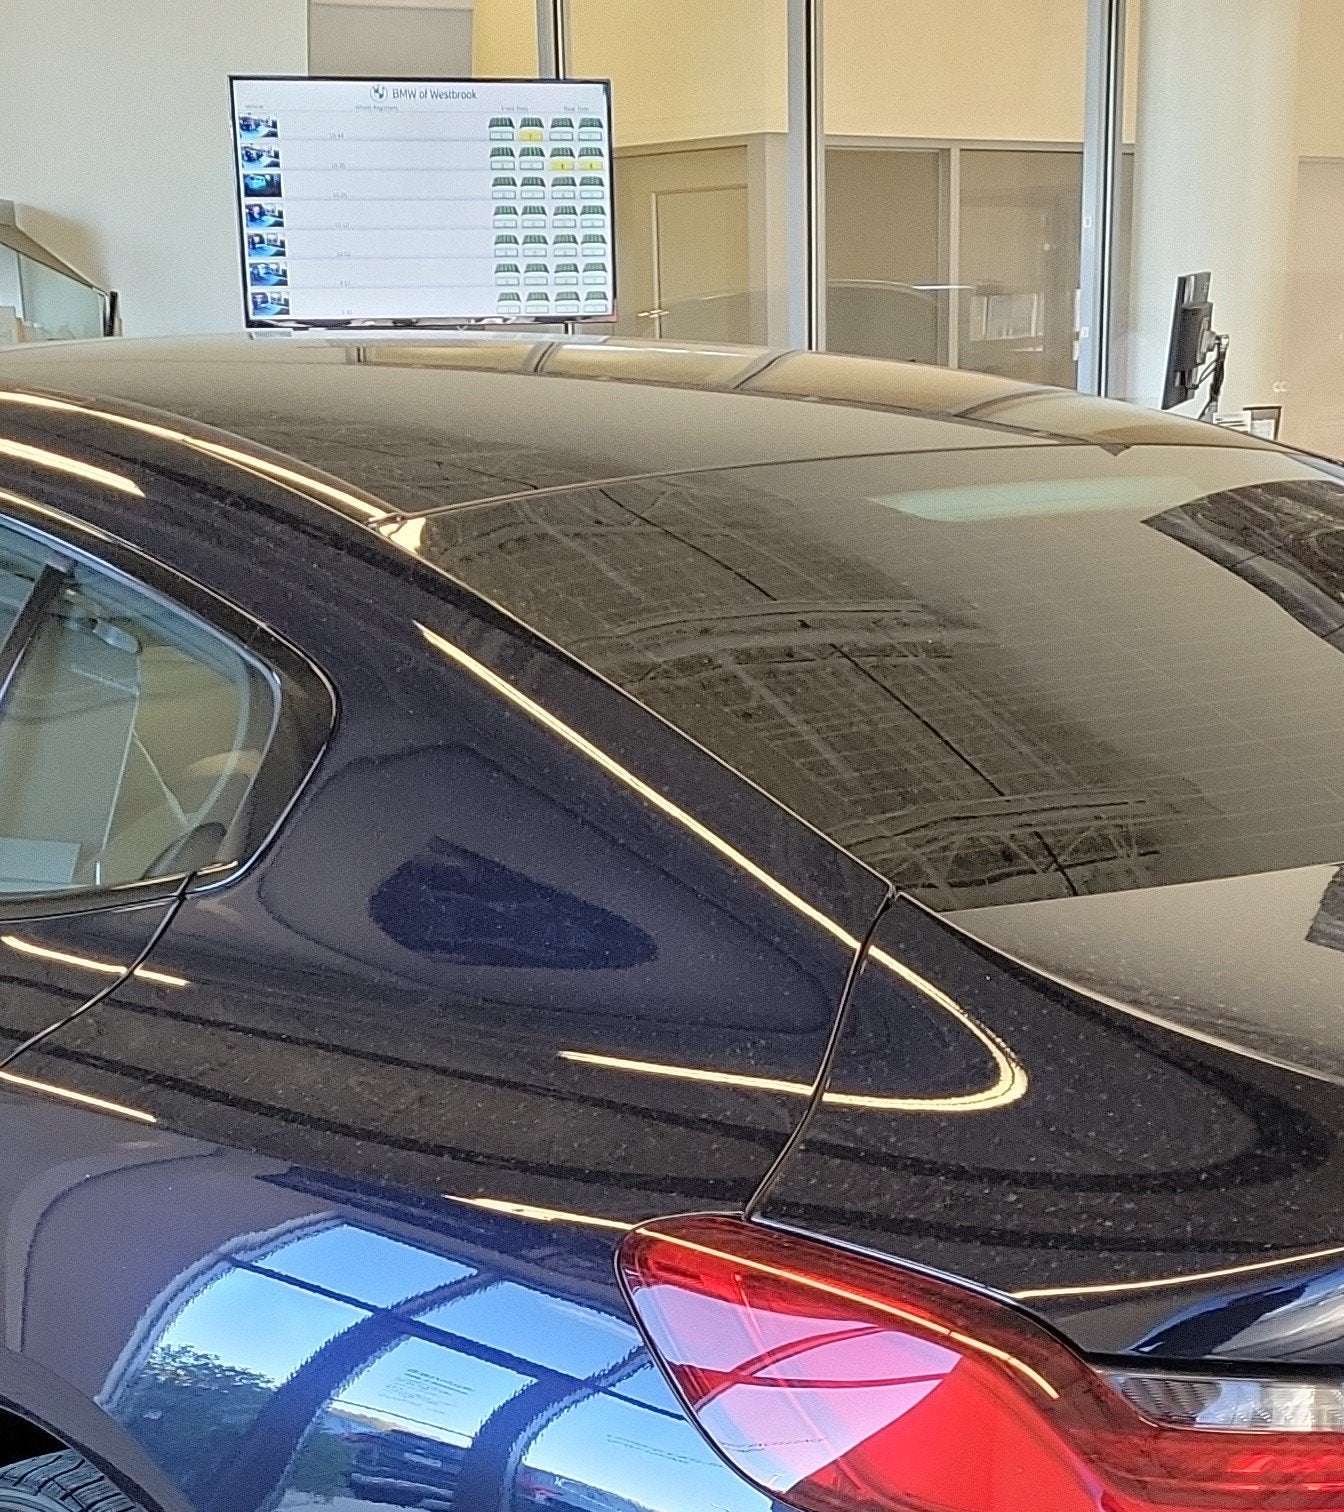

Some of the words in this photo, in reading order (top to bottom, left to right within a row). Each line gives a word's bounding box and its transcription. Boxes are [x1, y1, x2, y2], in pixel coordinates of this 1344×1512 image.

[392, 88, 417, 99] BMW
[419, 88, 428, 99] of
[429, 88, 477, 99] Westbrook
